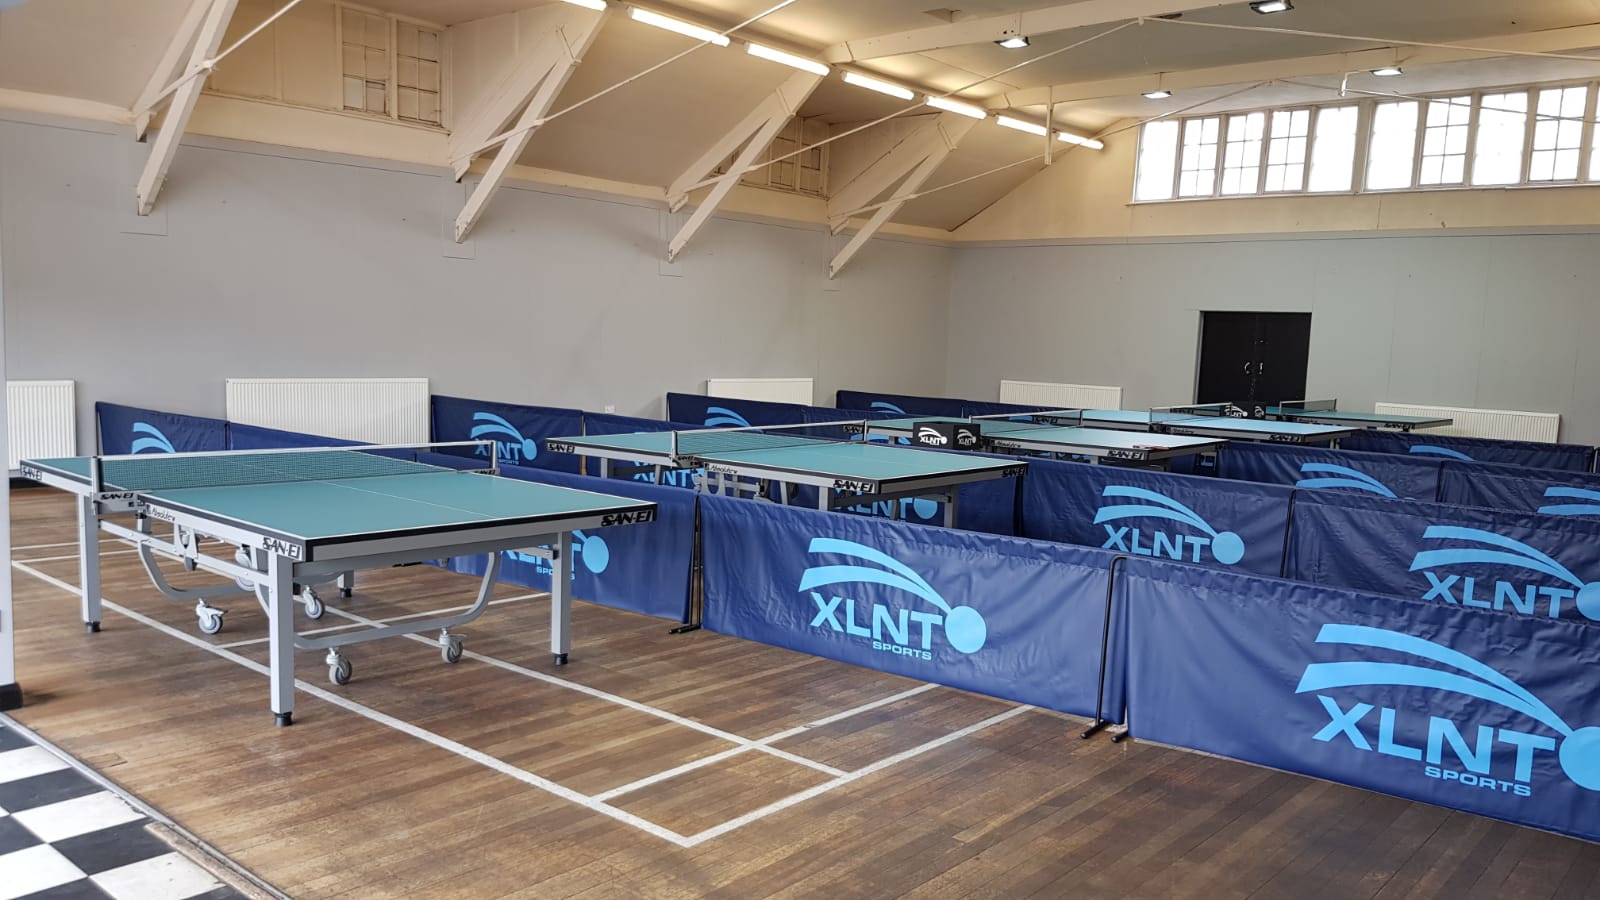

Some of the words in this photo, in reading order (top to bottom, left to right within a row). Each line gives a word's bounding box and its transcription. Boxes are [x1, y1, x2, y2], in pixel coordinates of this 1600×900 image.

[920, 436, 941, 446] XLNT
[1102, 524, 1210, 563] XLNT
[1422, 572, 1575, 618] XLNT
[810, 592, 943, 650] XLNT
[872, 641, 932, 661] SPORTS
[1312, 695, 1556, 782] XLNT
[1425, 766, 1532, 797] SPORTS
